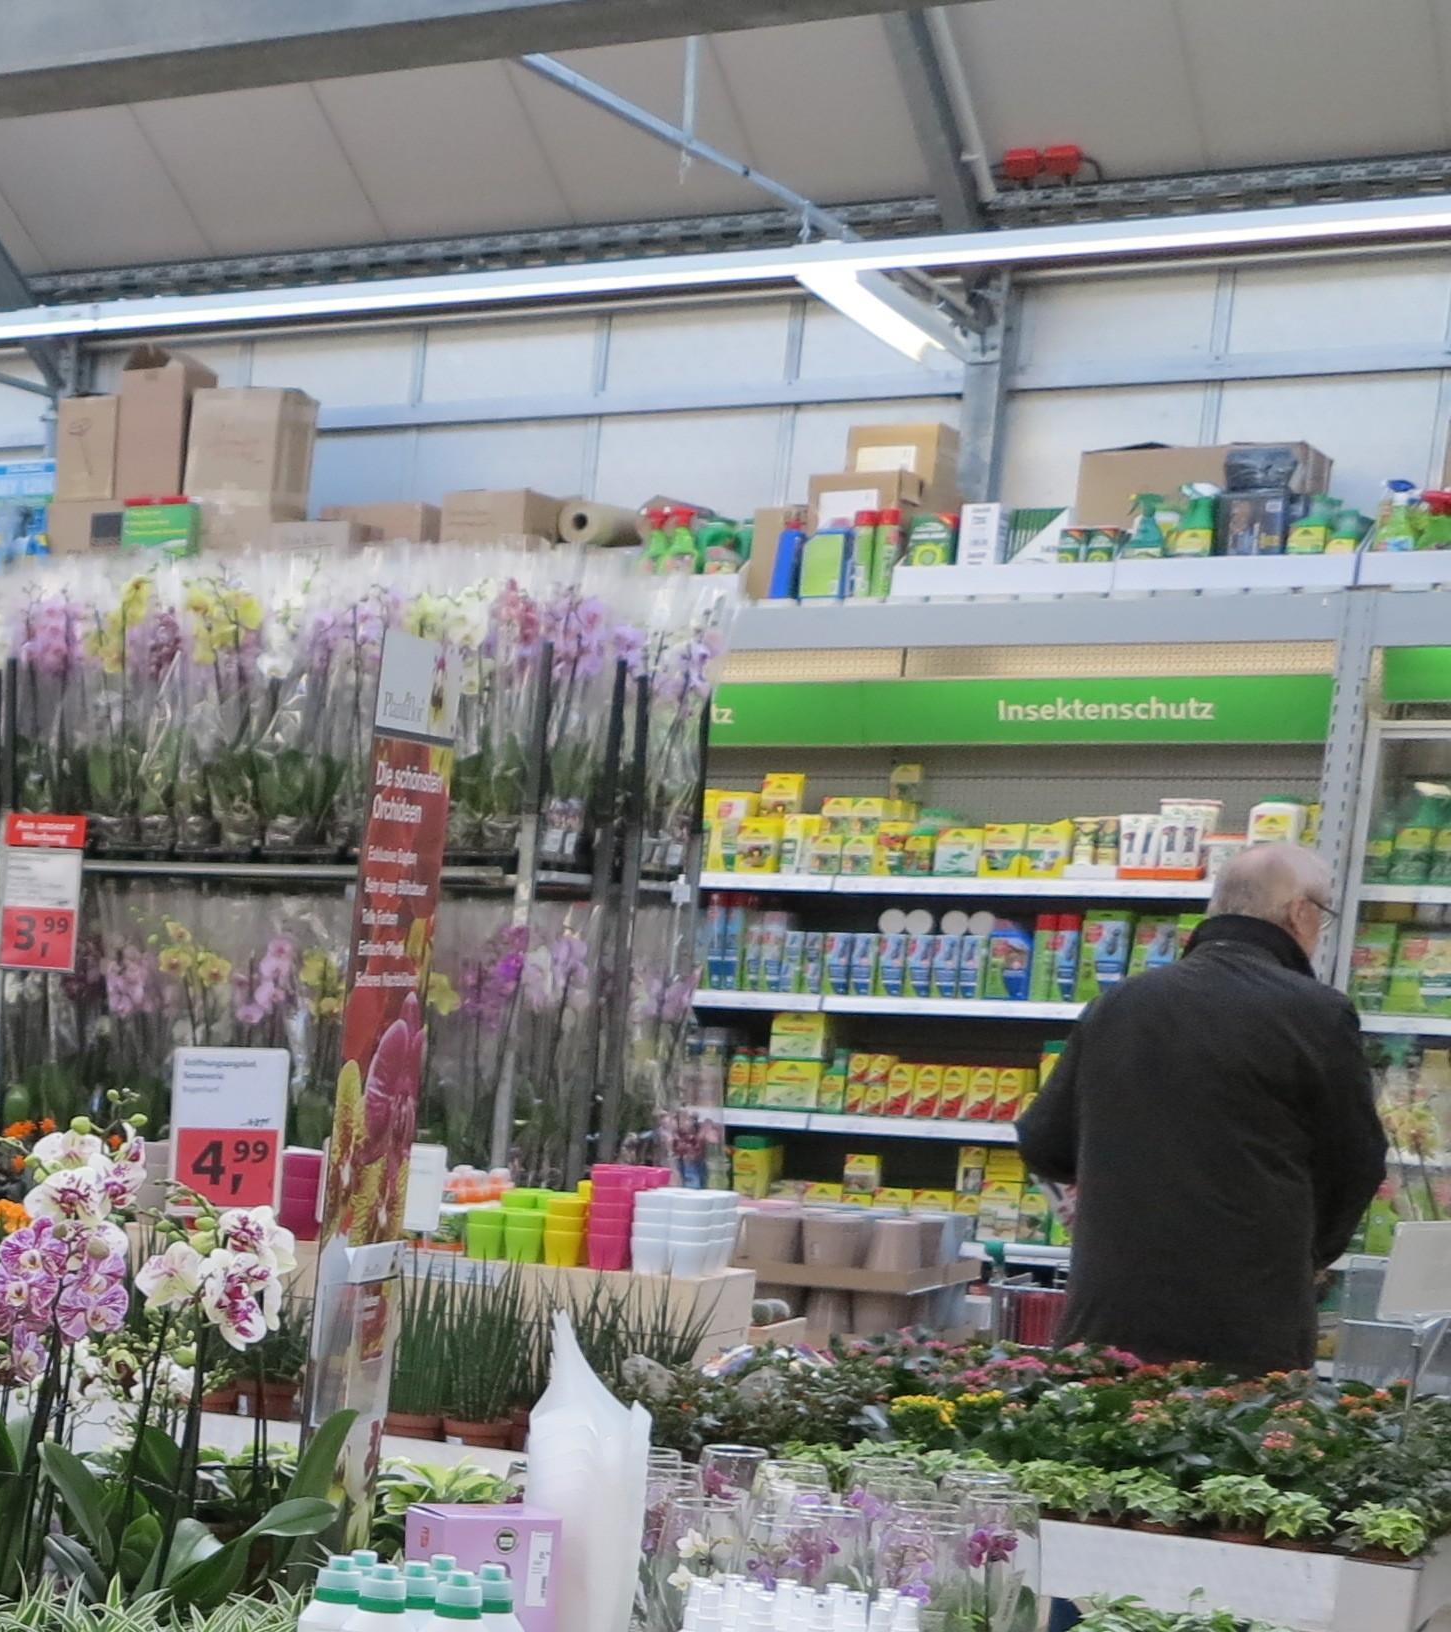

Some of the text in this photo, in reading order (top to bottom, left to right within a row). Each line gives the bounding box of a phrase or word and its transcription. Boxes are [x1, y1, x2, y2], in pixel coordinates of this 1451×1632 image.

[998, 696, 1215, 721] Insektenschutz
[376, 760, 443, 794] Die schönsten
[373, 794, 422, 823] Orchideen
[13, 914, 69, 957] 3,99
[192, 1140, 269, 1195] 4,99
